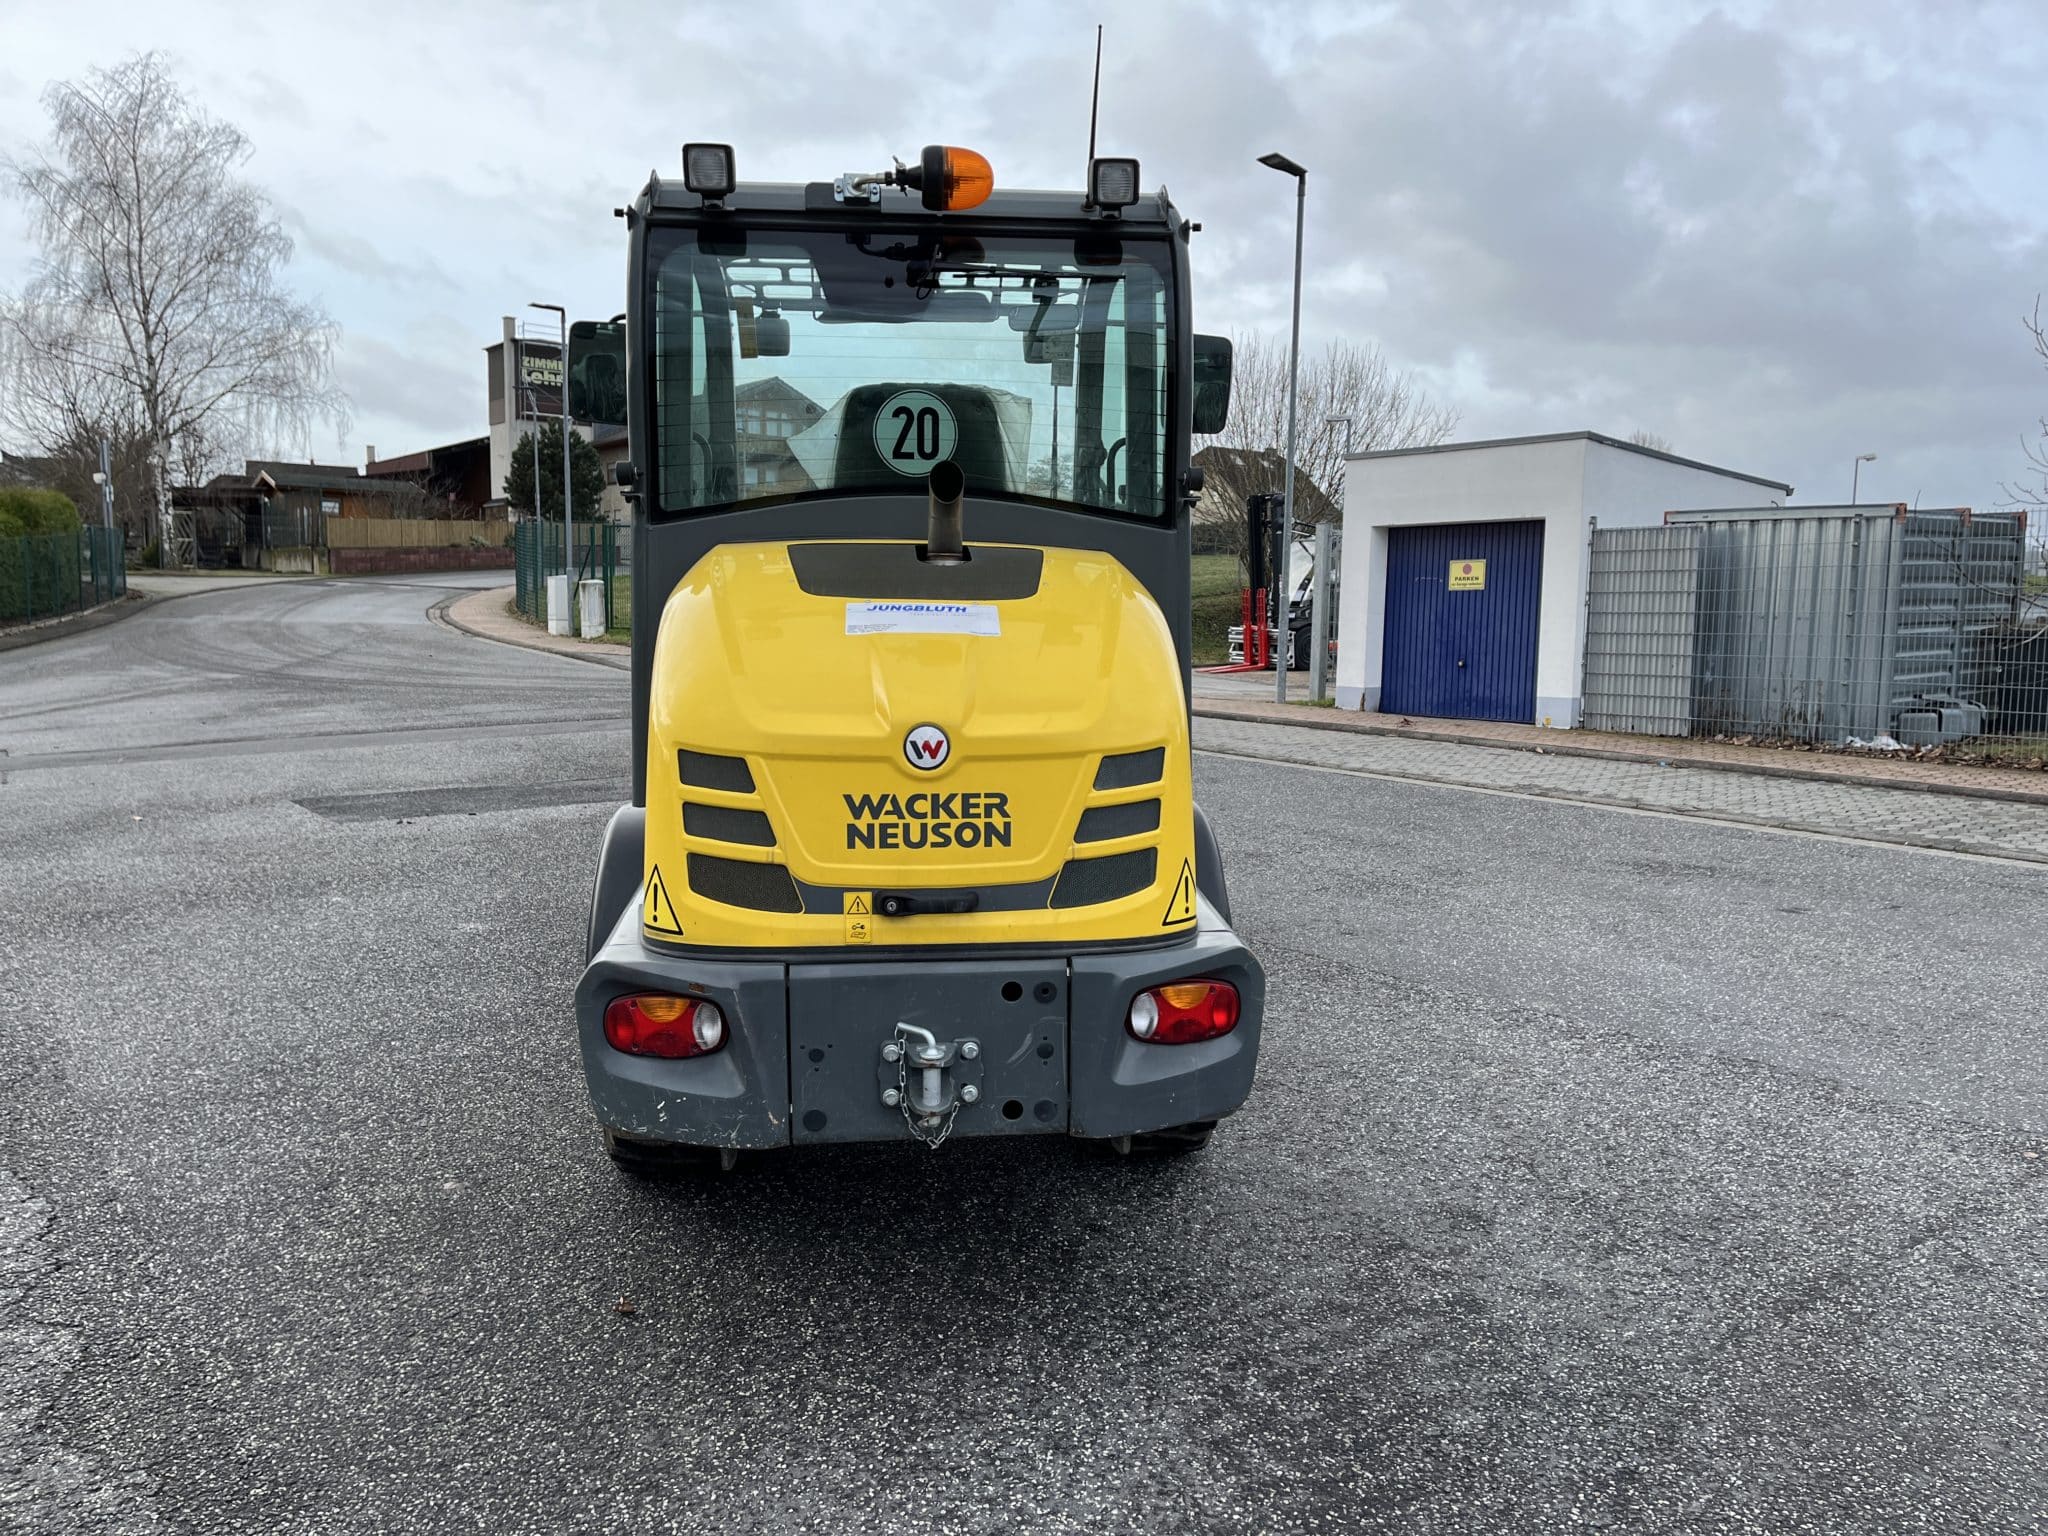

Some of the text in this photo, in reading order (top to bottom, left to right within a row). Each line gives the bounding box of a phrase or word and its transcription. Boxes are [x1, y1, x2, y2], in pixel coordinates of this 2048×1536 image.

[891, 406, 940, 460] 20
[867, 605, 968, 613] JUNGBLUTH
[909, 740, 944, 760] W
[842, 792, 1012, 820] WACKER
[846, 821, 1012, 849] NEUSON
